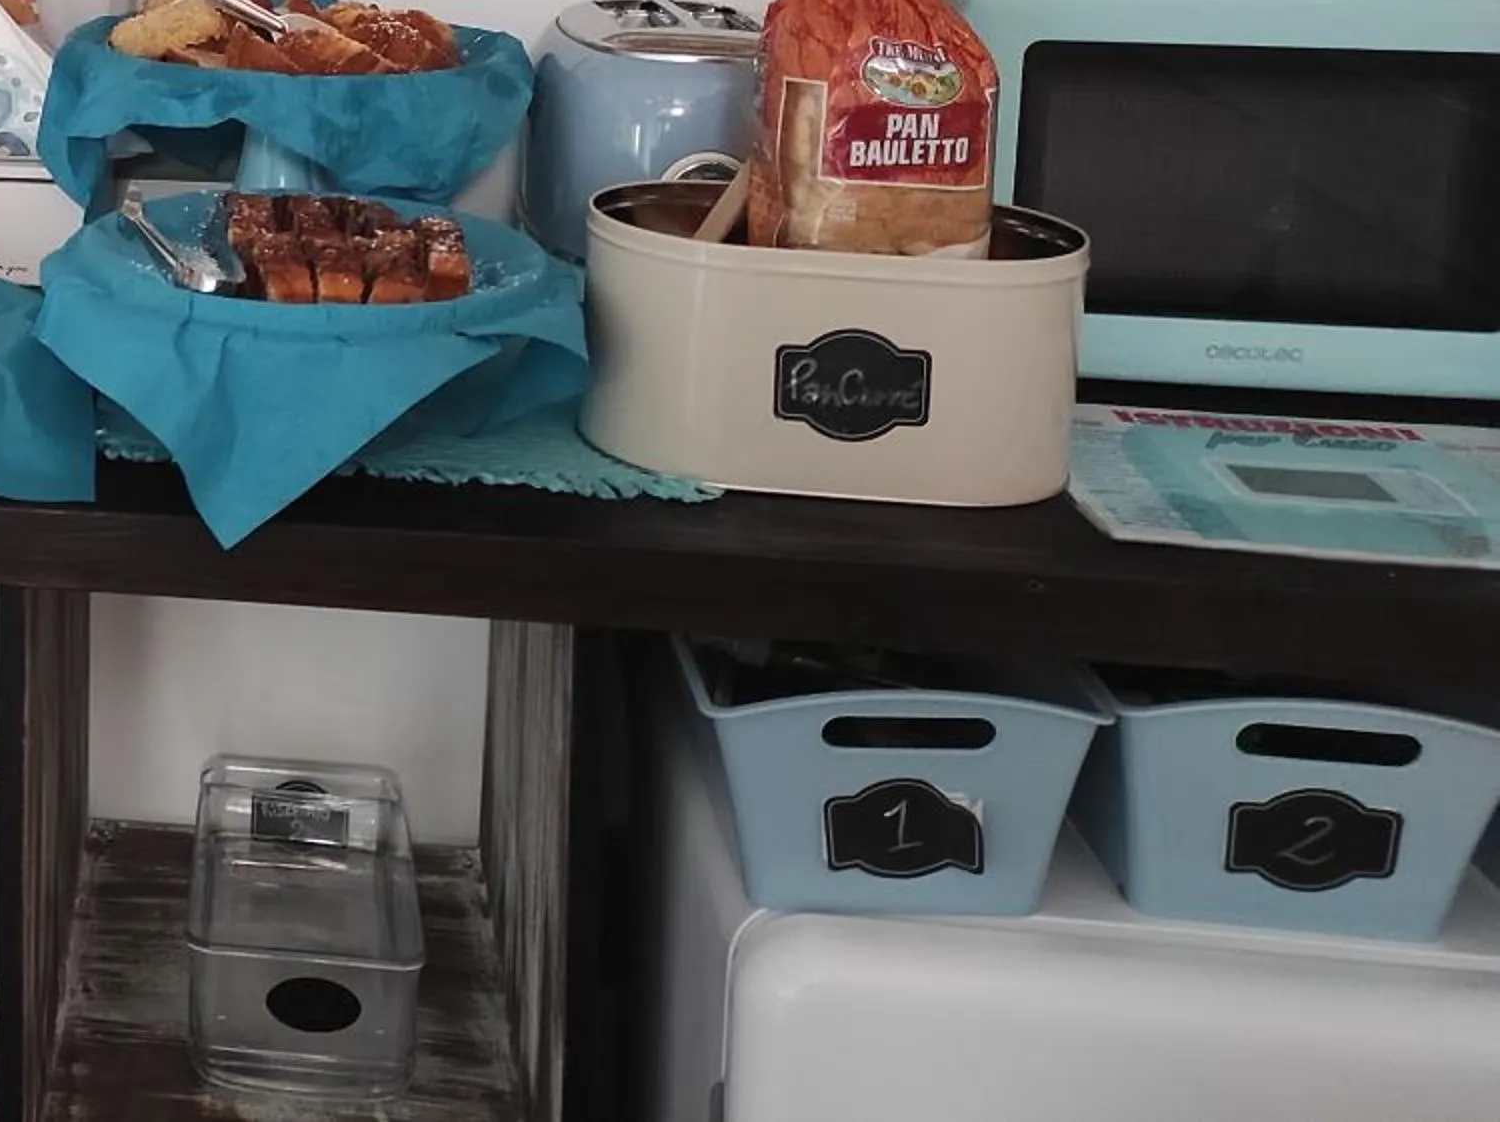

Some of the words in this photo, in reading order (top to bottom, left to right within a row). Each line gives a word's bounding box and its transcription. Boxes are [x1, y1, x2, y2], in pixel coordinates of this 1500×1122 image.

[885, 112, 940, 139] PAN
[849, 137, 969, 167] BAULETTO
[883, 799, 923, 852] 1
[1276, 816, 1335, 864] 2
